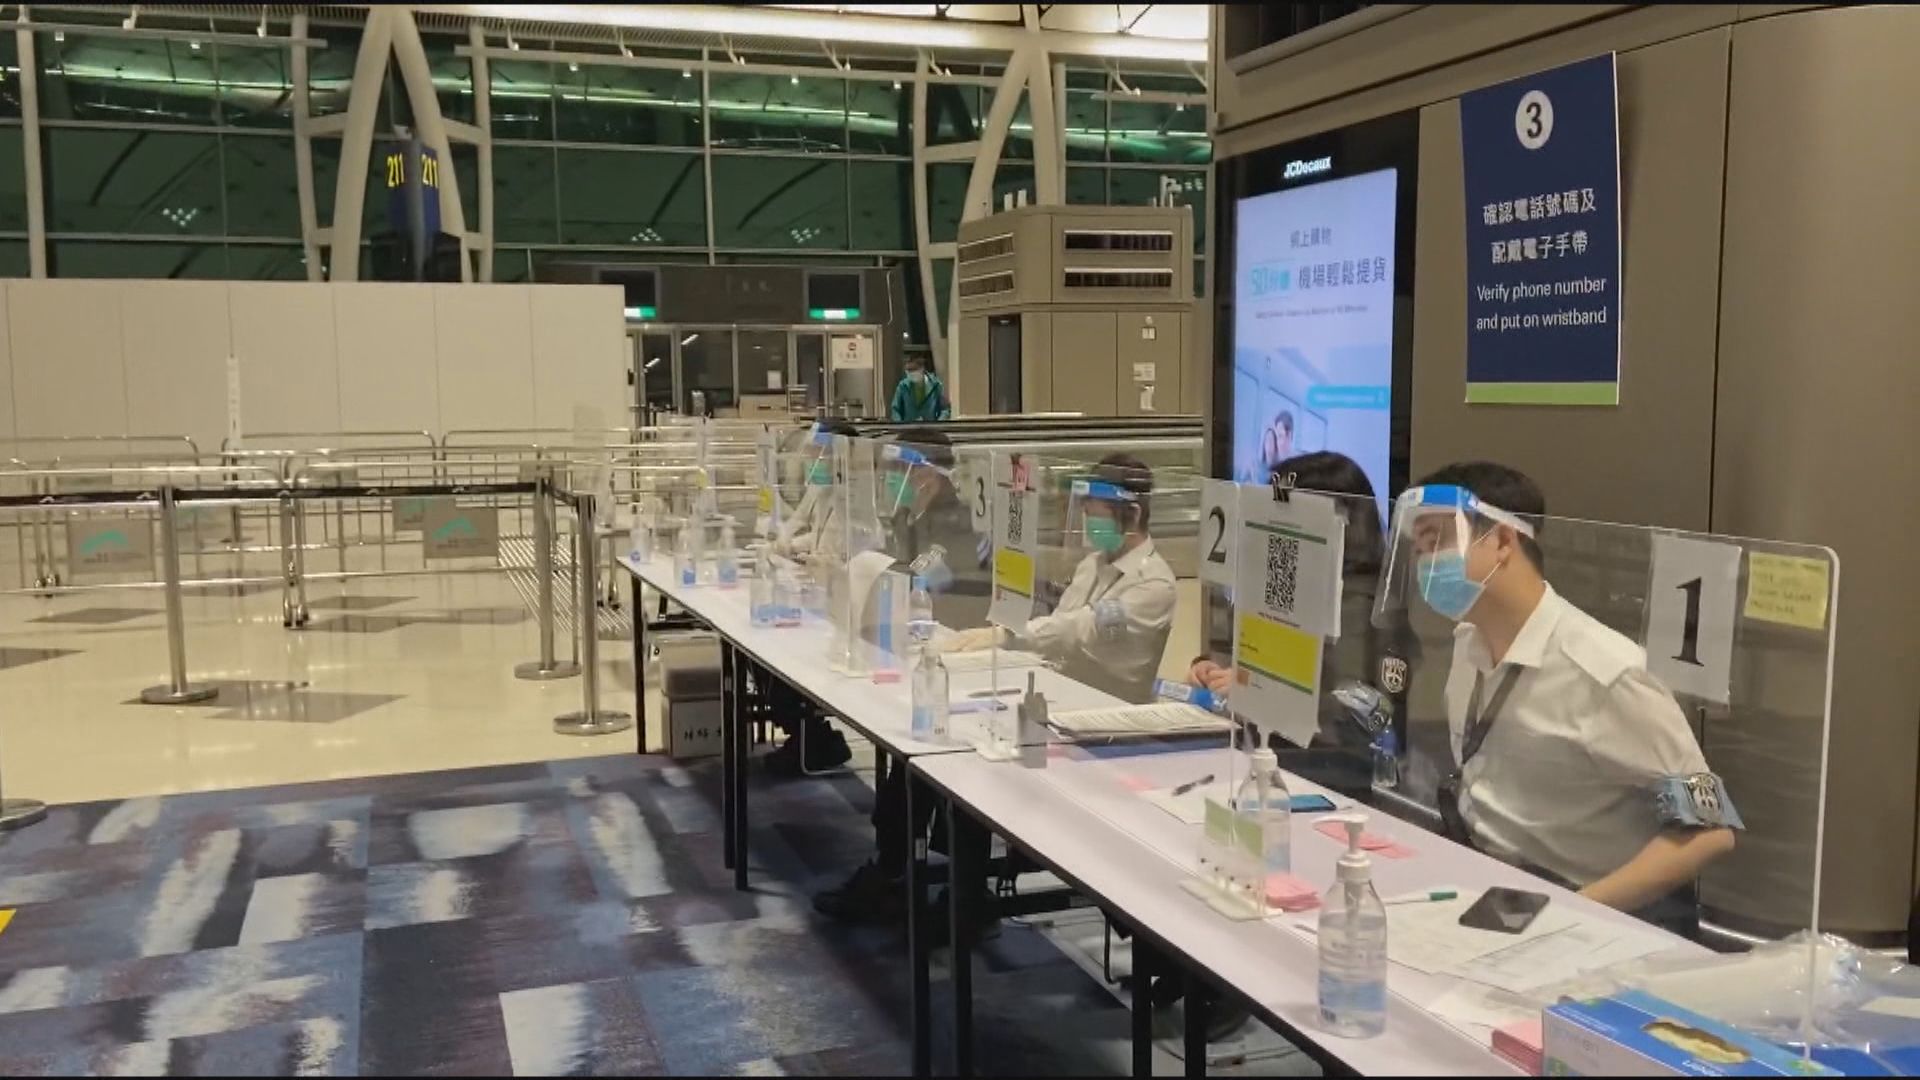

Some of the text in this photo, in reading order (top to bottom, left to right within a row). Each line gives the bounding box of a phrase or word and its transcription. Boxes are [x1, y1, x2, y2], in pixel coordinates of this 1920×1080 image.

[1526, 102, 1543, 138] 3
[387, 153, 404, 187] 211
[422, 154, 439, 188] 211
[1283, 156, 1332, 178] JCDecaux
[1483, 188, 1596, 225] 確認電話號碼及
[1477, 276, 1607, 302] Verify phone number
[1476, 307, 1607, 332] and put on wristband
[976, 477, 986, 518] 3
[1207, 506, 1227, 563] 2
[1671, 576, 1704, 667] 1
